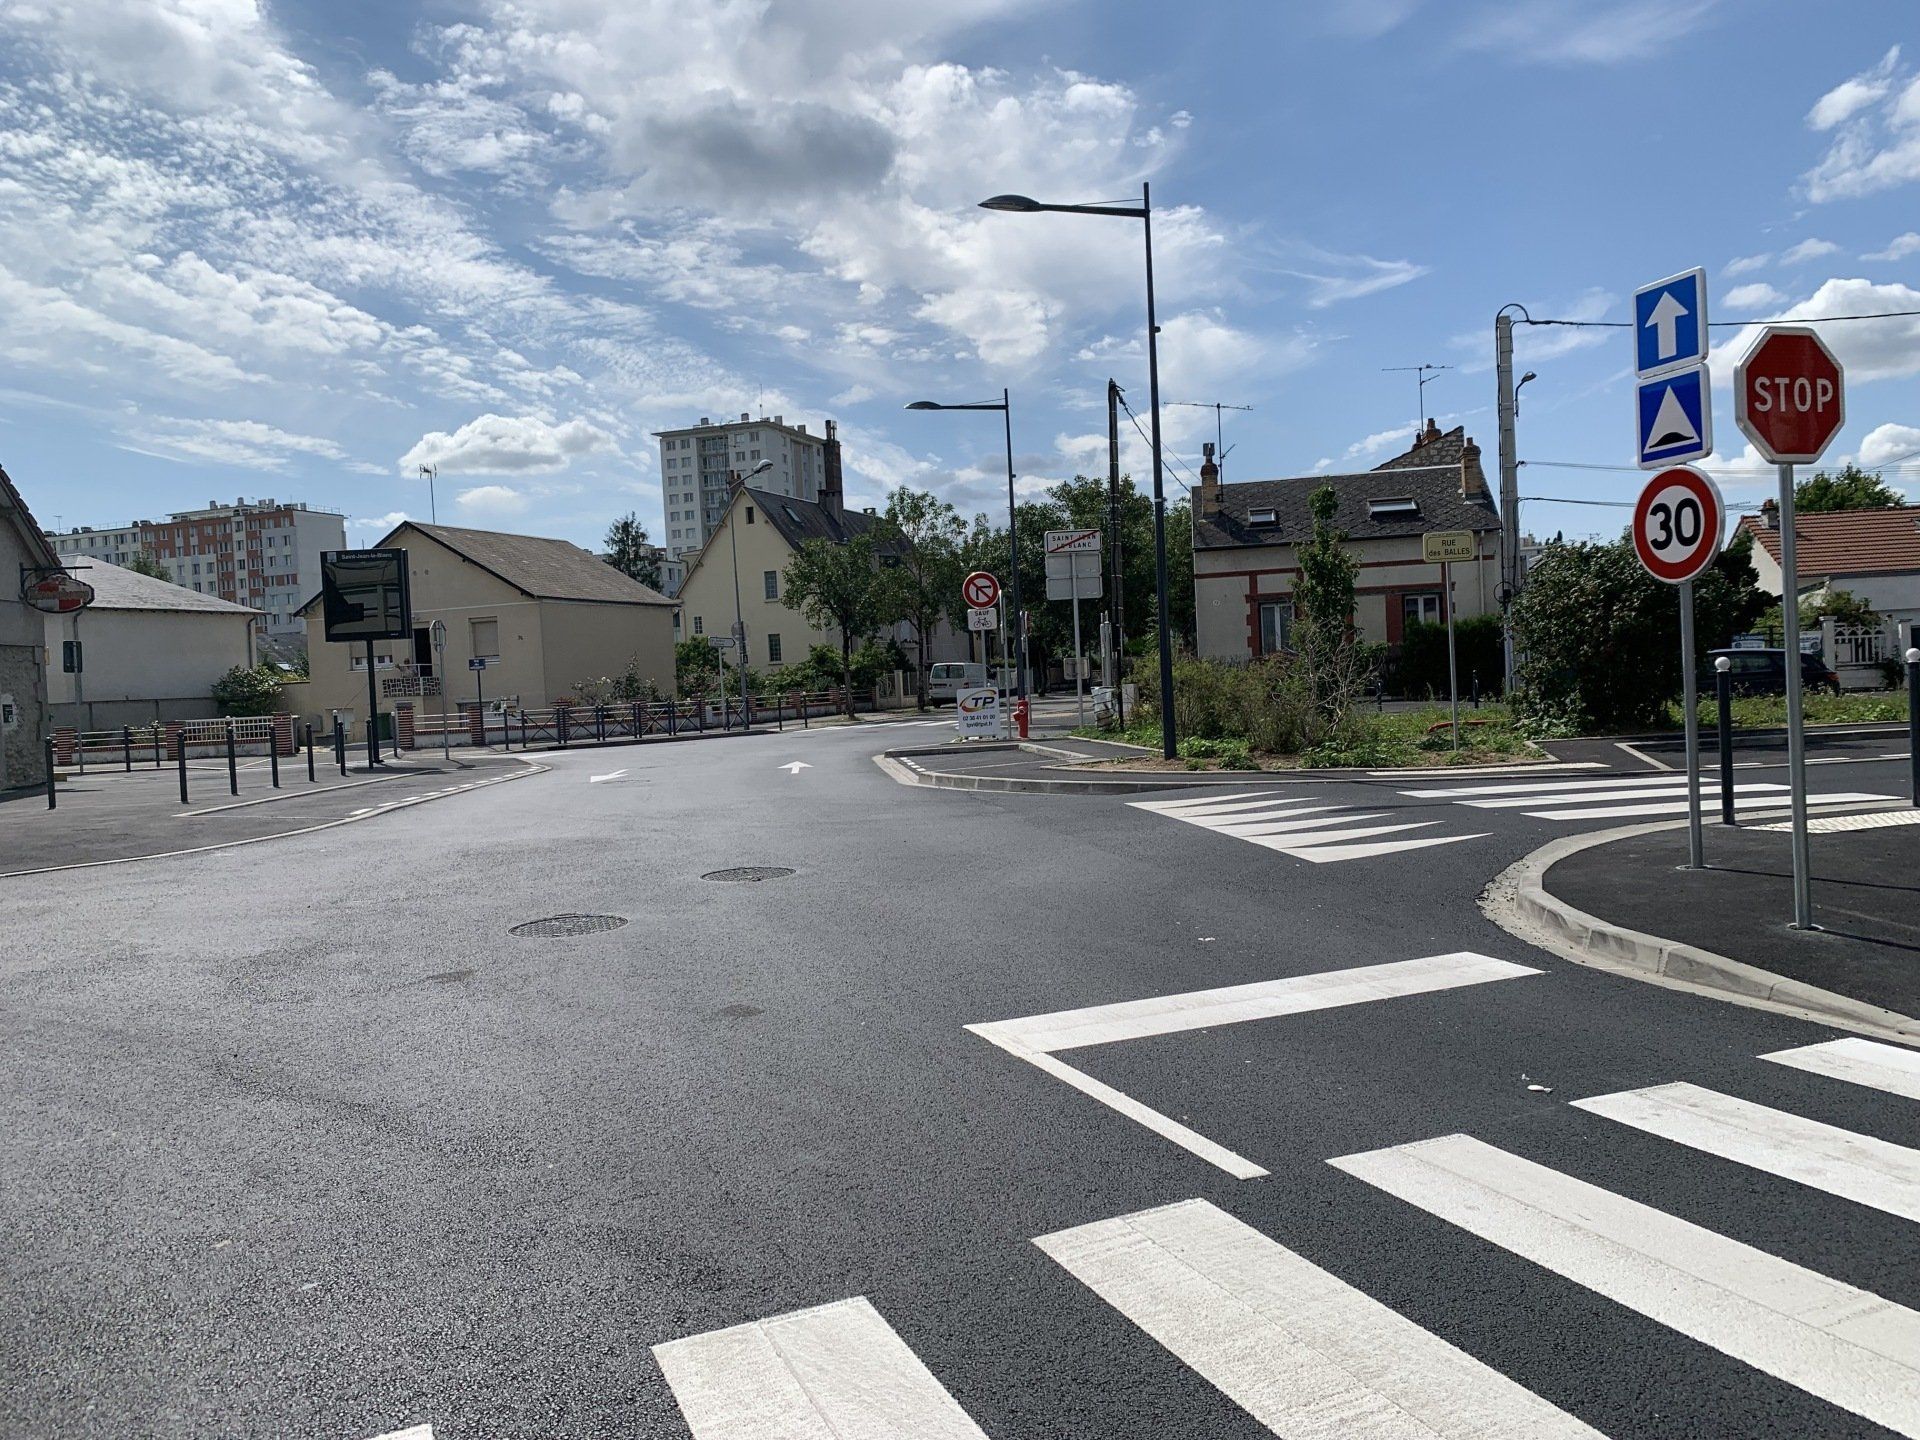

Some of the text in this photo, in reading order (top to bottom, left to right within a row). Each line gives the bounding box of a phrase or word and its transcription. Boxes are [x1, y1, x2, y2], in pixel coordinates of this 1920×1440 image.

[1753, 375, 1835, 414] STOP
[1648, 496, 1702, 552] 30
[1068, 541, 1092, 549] BLANC
[1441, 539, 1457, 547] RUE
[1428, 547, 1471, 557] des BALLES
[972, 697, 995, 707] TP
